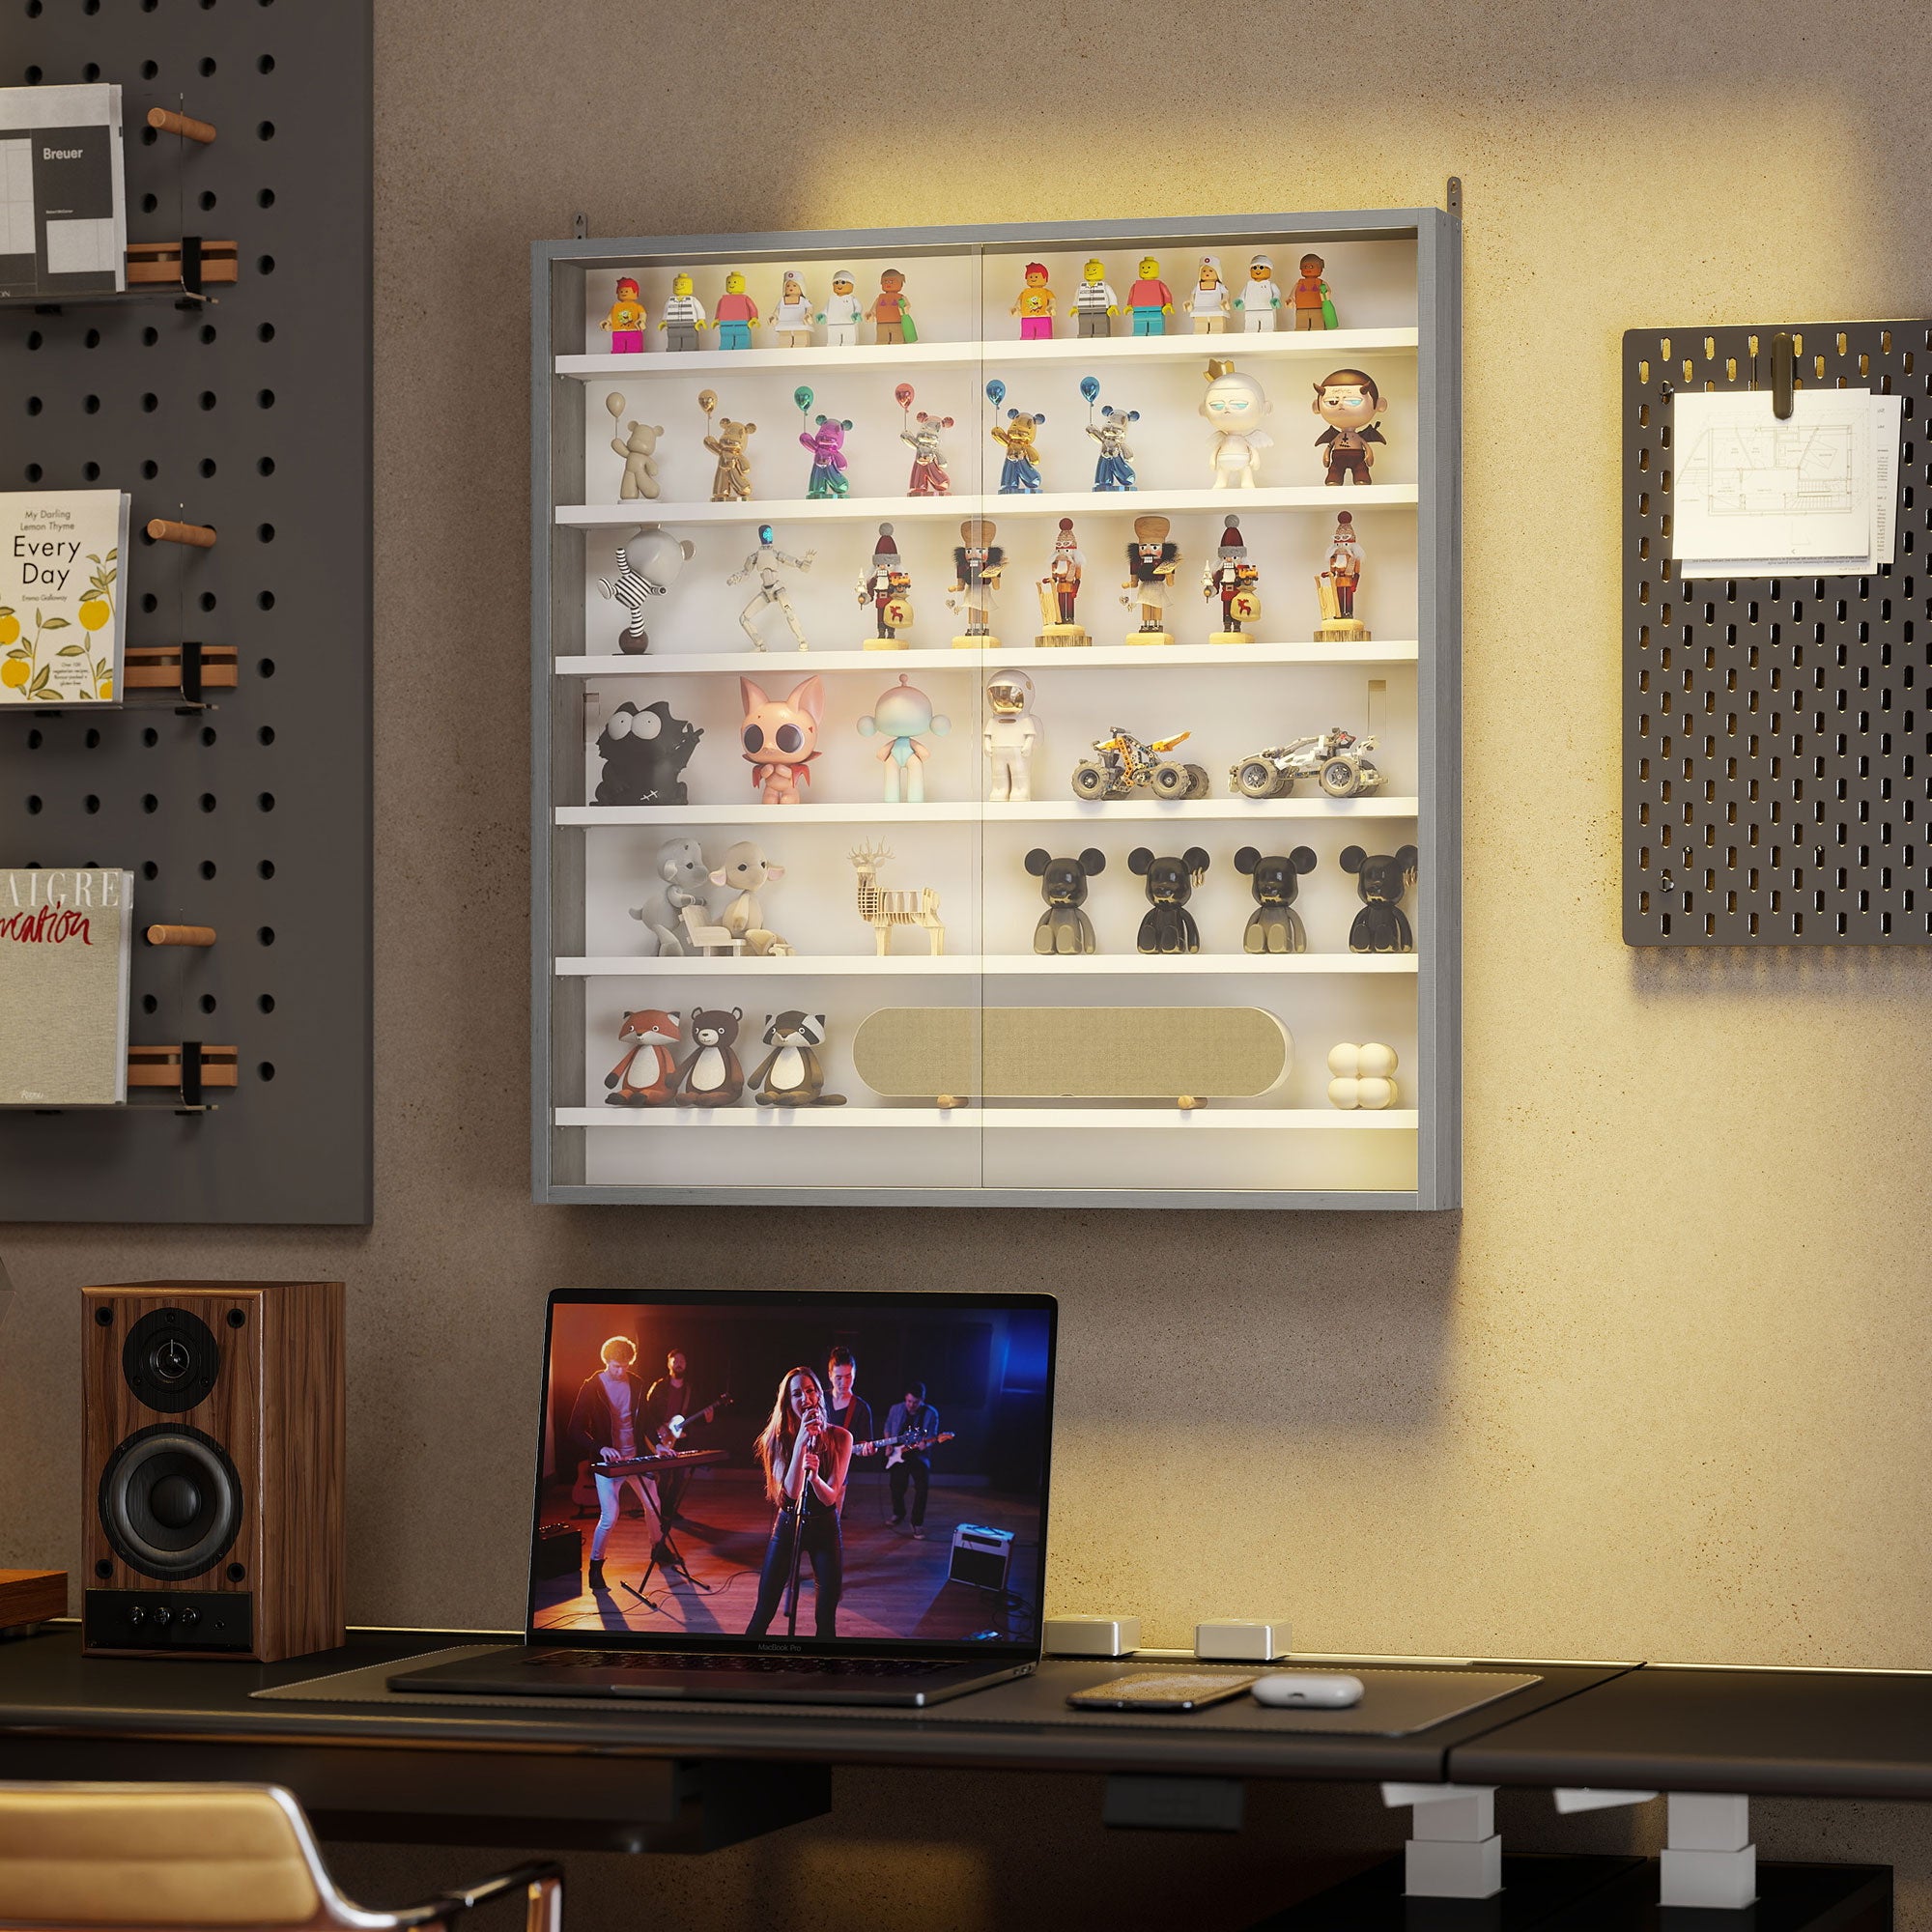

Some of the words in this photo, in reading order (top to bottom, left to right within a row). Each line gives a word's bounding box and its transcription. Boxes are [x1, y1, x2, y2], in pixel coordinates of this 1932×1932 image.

[43, 147, 84, 160] Breuer
[25, 510, 38, 522] My
[40, 509, 71, 521] Darling
[19, 523, 46, 531] Lemon
[48, 522, 75, 532] Thyme
[14, 534, 81, 563] Every
[22, 562, 71, 591] Day
[757, 1642, 789, 1652] MacBook
